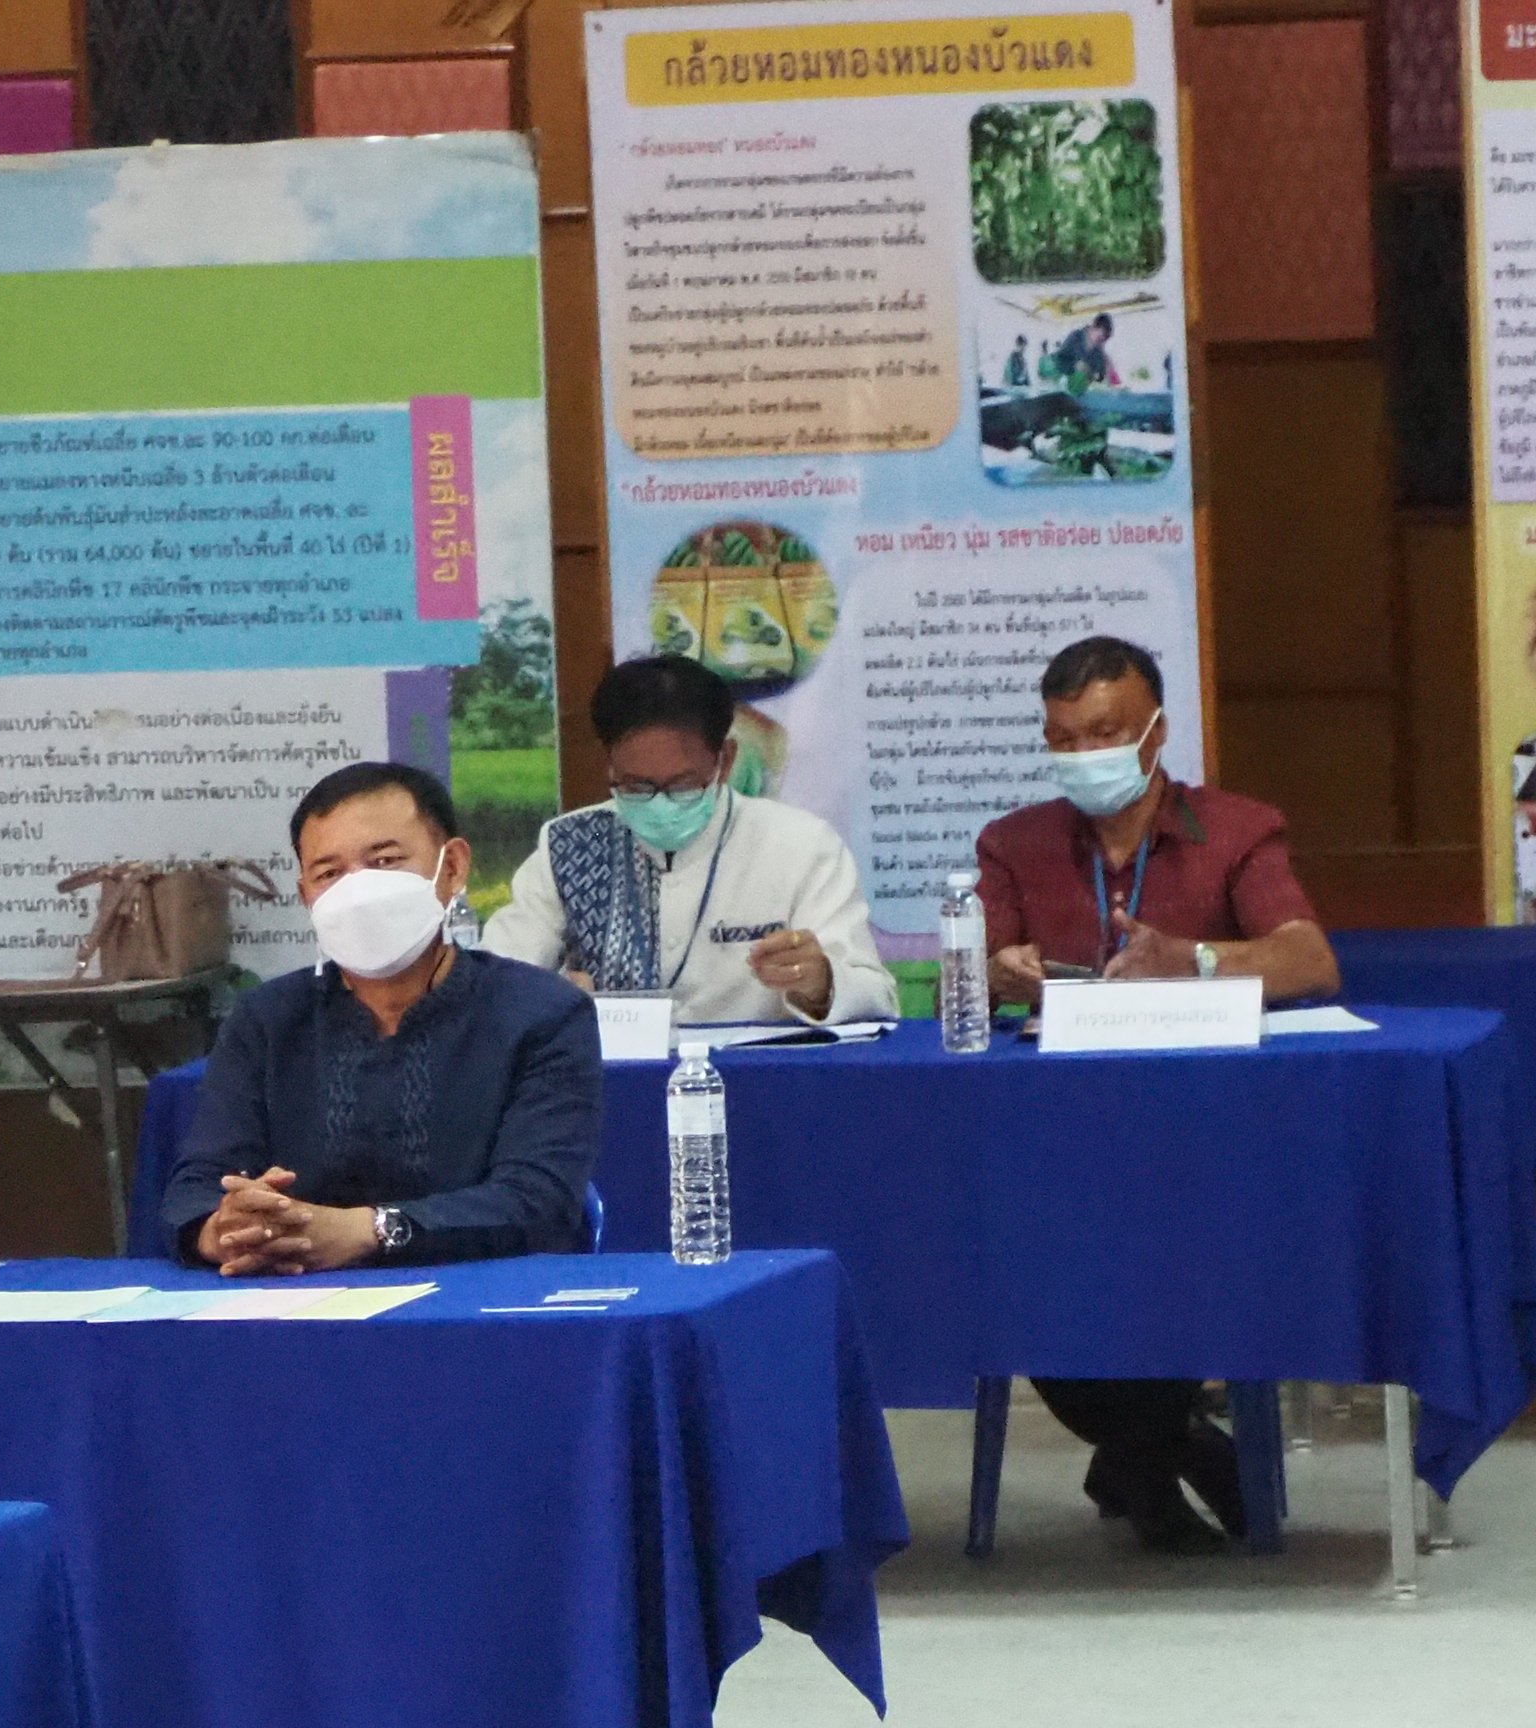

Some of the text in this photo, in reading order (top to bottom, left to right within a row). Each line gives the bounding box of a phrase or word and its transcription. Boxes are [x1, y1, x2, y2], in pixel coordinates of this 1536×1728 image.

[662, 27, 1095, 90] กล้วยหอมทองหนองบัวแดง
[427, 431, 477, 583] ผลสำเร็จ
[855, 514, 1184, 557] หอม เหนียว นุ่ม รสชาติอร่อย ปลอดภัย
[0, 818, 44, 843] ต่อไป
